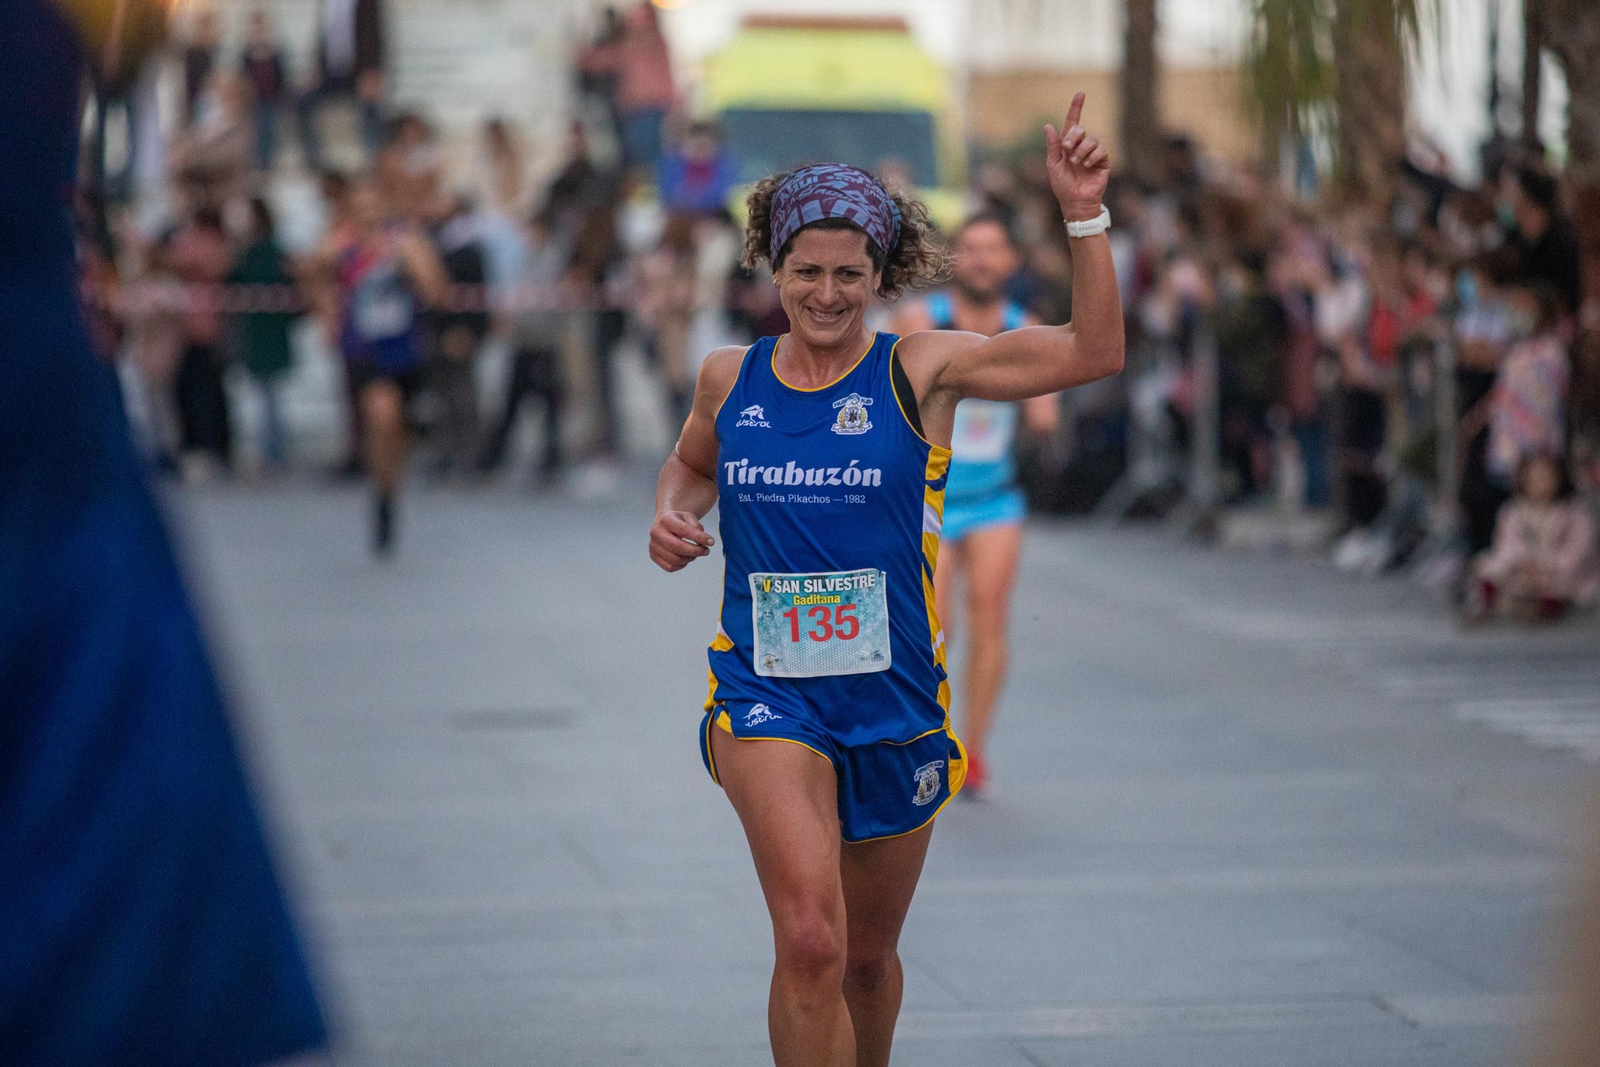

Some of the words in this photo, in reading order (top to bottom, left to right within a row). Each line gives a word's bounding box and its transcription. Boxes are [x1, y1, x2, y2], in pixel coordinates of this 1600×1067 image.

[724, 458, 882, 487] Tirabuzón
[738, 493, 755, 502] Est.
[756, 492, 785, 503] Piedra
[788, 494, 831, 504] Pikachos
[762, 579, 771, 592] V
[774, 580, 800, 593] SAN
[803, 574, 876, 593] SILVESTRE
[793, 594, 841, 605] Gaditana
[782, 603, 860, 643] 135
